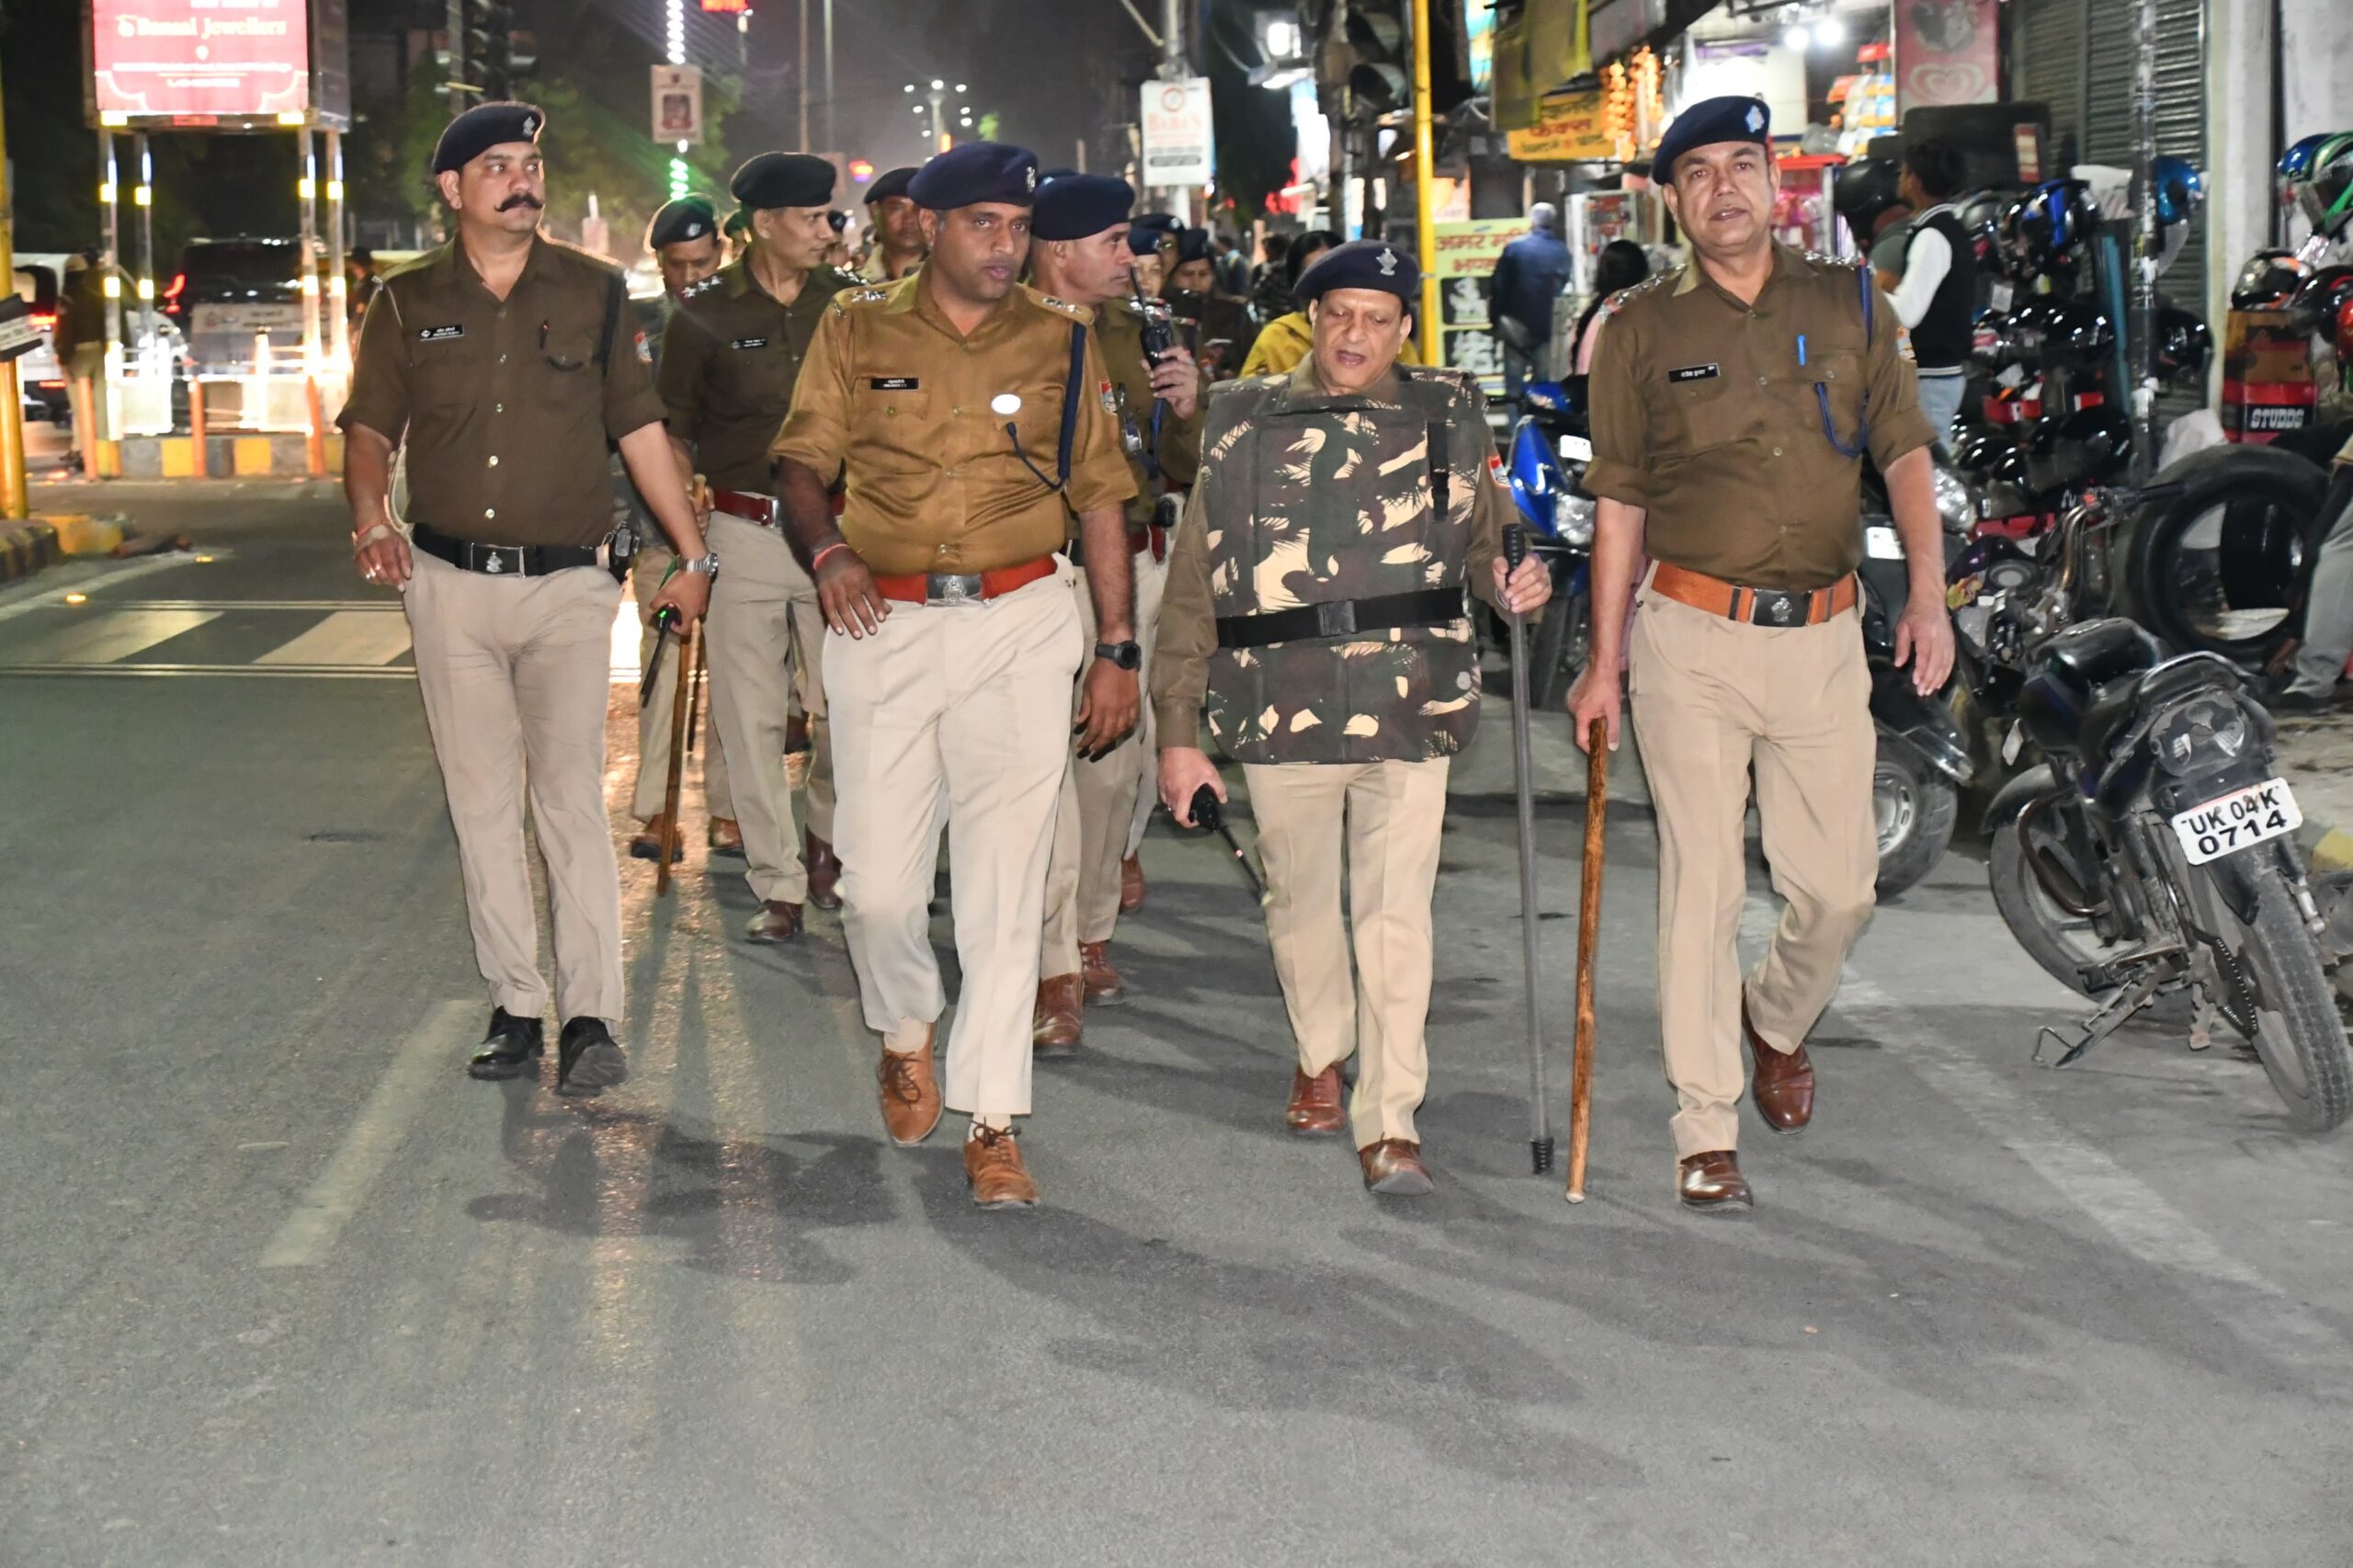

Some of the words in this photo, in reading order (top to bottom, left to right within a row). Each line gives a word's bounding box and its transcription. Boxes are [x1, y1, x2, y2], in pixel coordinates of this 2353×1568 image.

[201, 17, 288, 40] Jewellers
[2250, 408, 2305, 429] STUDDS
[2188, 808, 2227, 835] UK
[2198, 810, 2288, 856] 0714
